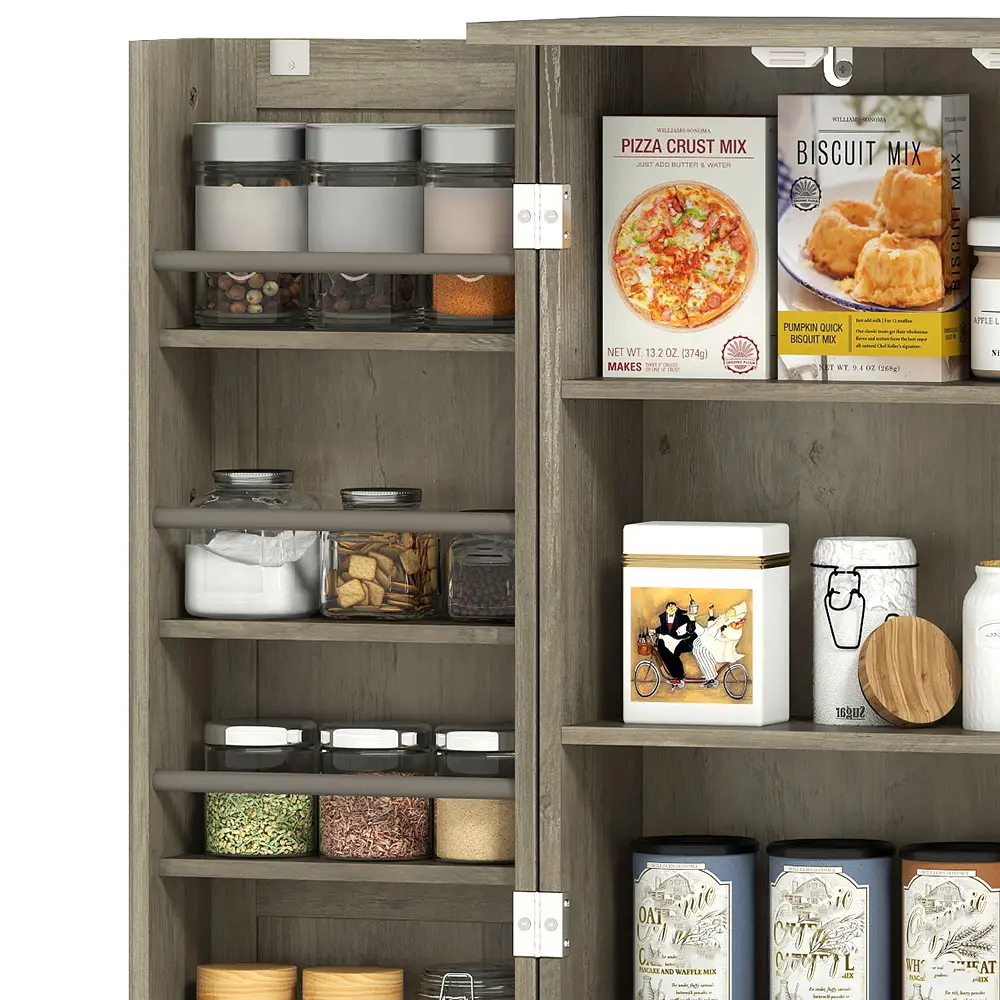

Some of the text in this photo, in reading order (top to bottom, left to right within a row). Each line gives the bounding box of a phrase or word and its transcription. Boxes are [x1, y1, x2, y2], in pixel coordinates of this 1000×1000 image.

[621, 139, 747, 154] PIZZA CRUST MIX
[797, 140, 921, 166] BISCUIT MIX
[951, 153, 960, 291] BISCUIT MIX
[784, 322, 843, 332] PUMPKIN QUICK
[790, 335, 836, 344] BISQUIT MIX
[607, 347, 708, 360] NET WT. 13.2 OZ. (374g)
[607, 362, 642, 372] MAKES
